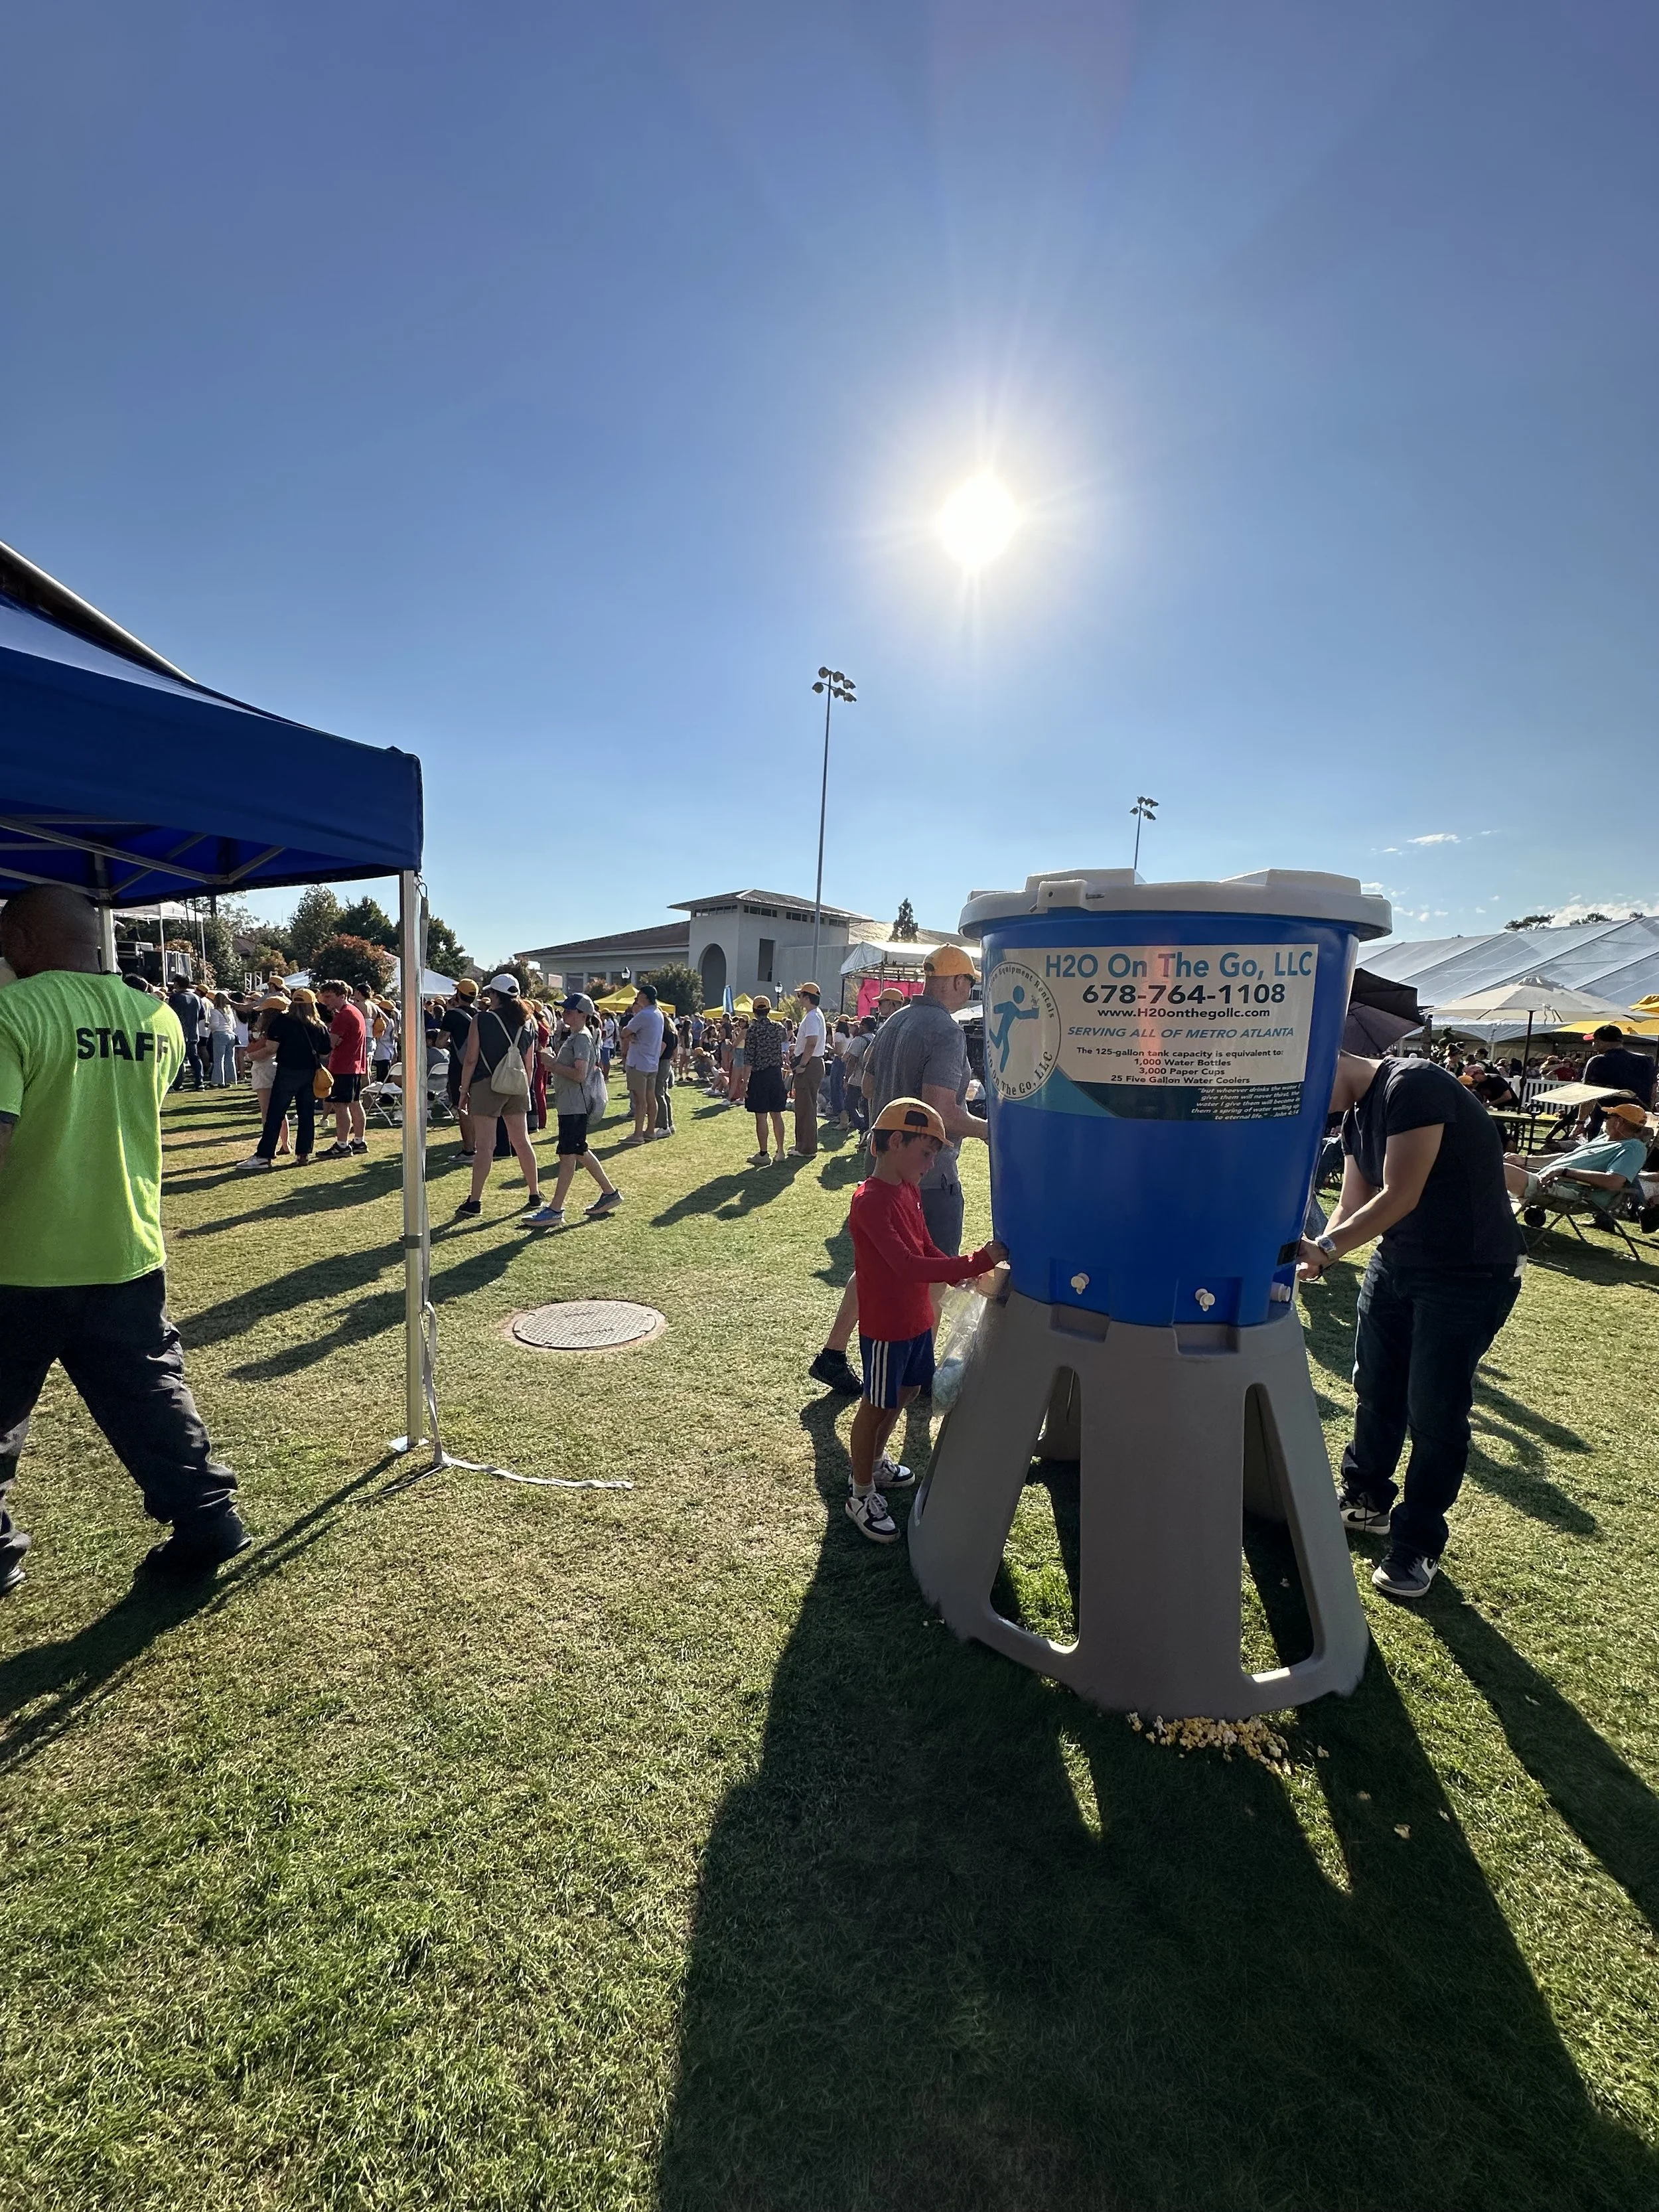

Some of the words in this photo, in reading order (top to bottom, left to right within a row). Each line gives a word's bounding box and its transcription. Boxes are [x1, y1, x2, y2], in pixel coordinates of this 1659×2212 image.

[1046, 954, 1098, 978] H2O
[1108, 953, 1147, 978] On
[1158, 952, 1209, 978] The
[1220, 952, 1264, 981] Go,
[1273, 951, 1313, 976] LLC
[999, 965, 1033, 982] Equipment
[1034, 980, 1054, 1018] Rentals
[1082, 984, 1285, 1004] 678-764-1108
[76, 1027, 170, 1063] STAFF
[1068, 1027, 1127, 1037] SERVING
[1129, 1029, 1156, 1038] ALL
[1161, 1029, 1183, 1038] OF
[1185, 1029, 1238, 1038] METRO
[1240, 1027, 1294, 1038] ATLANTA
[1096, 1048, 1145, 1057] 125-gallon
[1226, 1050, 1271, 1059] equivalent
[1001, 1080, 1016, 1096] The
[1019, 1081, 1037, 1094] Go,
[1035, 1051, 1052, 1080] LLC
[1169, 1068, 1198, 1076] Paper
